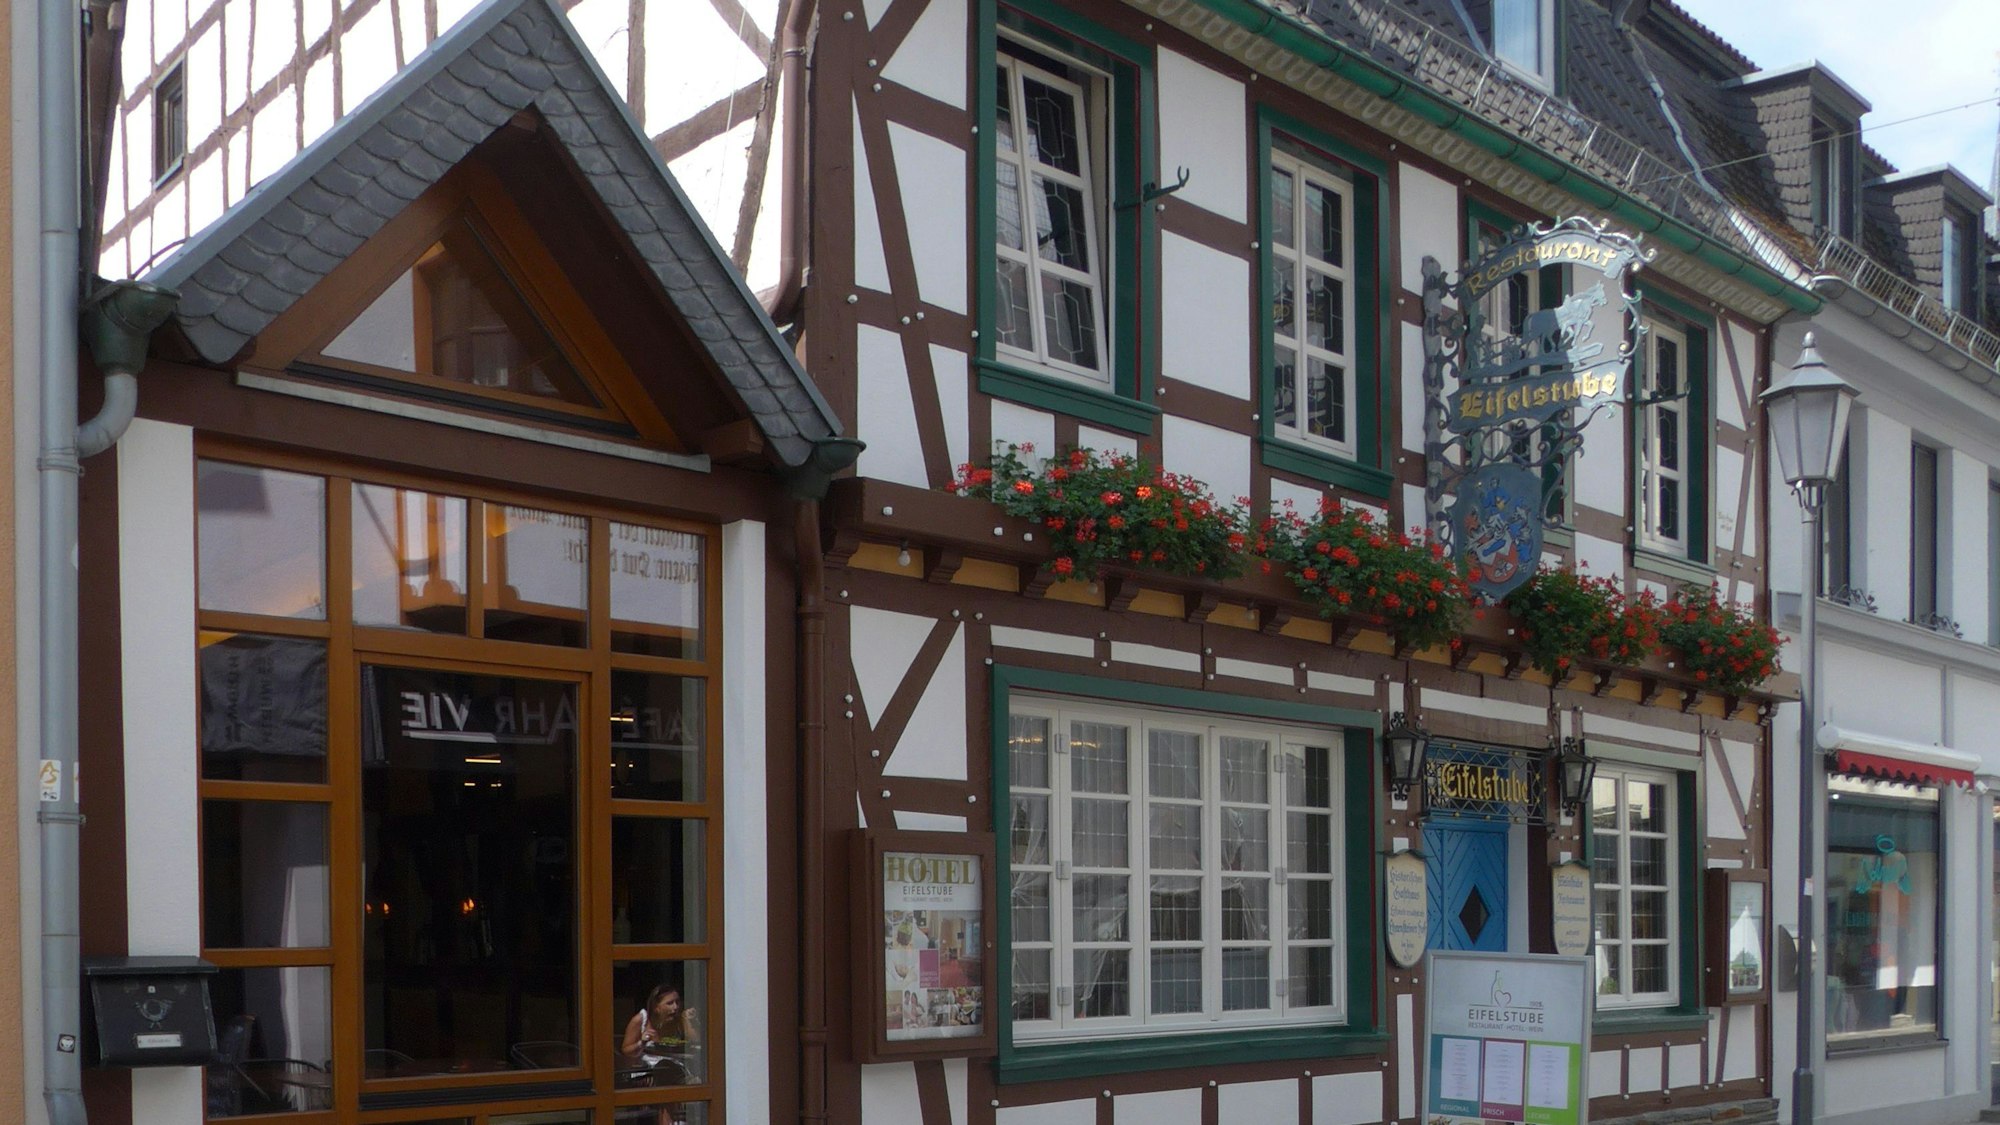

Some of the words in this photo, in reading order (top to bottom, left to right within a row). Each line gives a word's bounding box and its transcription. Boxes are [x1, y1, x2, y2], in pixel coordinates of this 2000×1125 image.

[1467, 242, 1618, 295] Restaurant
[1460, 371, 1617, 418] Eifelstube
[1441, 763, 1529, 803] Eifelstube
[887, 857, 976, 884] HOTEL
[903, 886, 953, 895] EIFELSTUBE
[1468, 1009, 1544, 1024] EIFELSTUBE
[1468, 1022, 1503, 1030] RESTAURANT
[1440, 1104, 1470, 1112] REGIONAL
[1483, 1107, 1504, 1116] FRISCH
